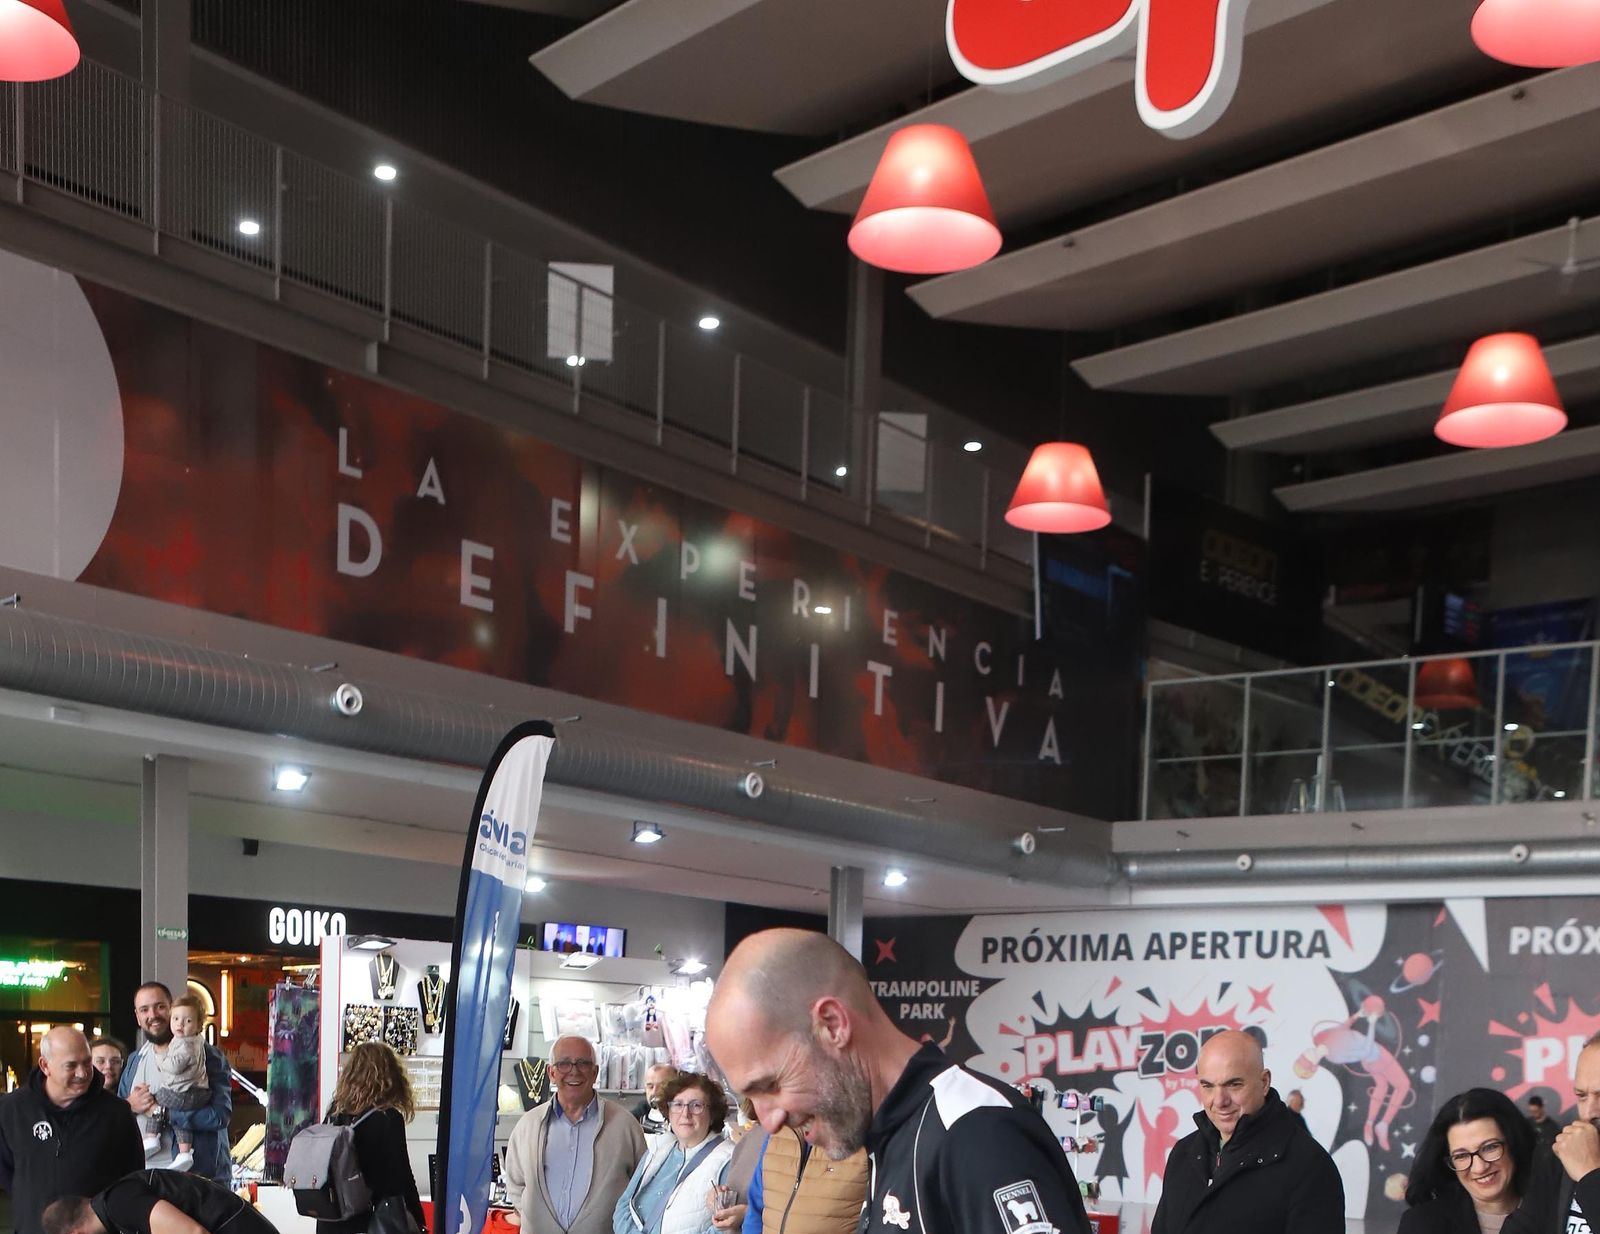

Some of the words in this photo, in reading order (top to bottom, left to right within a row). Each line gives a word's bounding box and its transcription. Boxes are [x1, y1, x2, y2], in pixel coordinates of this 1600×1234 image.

[337, 427, 446, 505] LA
[551, 497, 1064, 699] EXPERIENCIA
[336, 502, 1062, 765] DEFINITIVA
[269, 907, 346, 946] GOIKO
[981, 927, 1134, 964] PRÓXIMA
[1143, 930, 1332, 961] APERTURA
[869, 980, 980, 997] TRAMPOLINE
[900, 1003, 945, 1019] PARK
[1000, 1187, 1031, 1202] KENNEL
